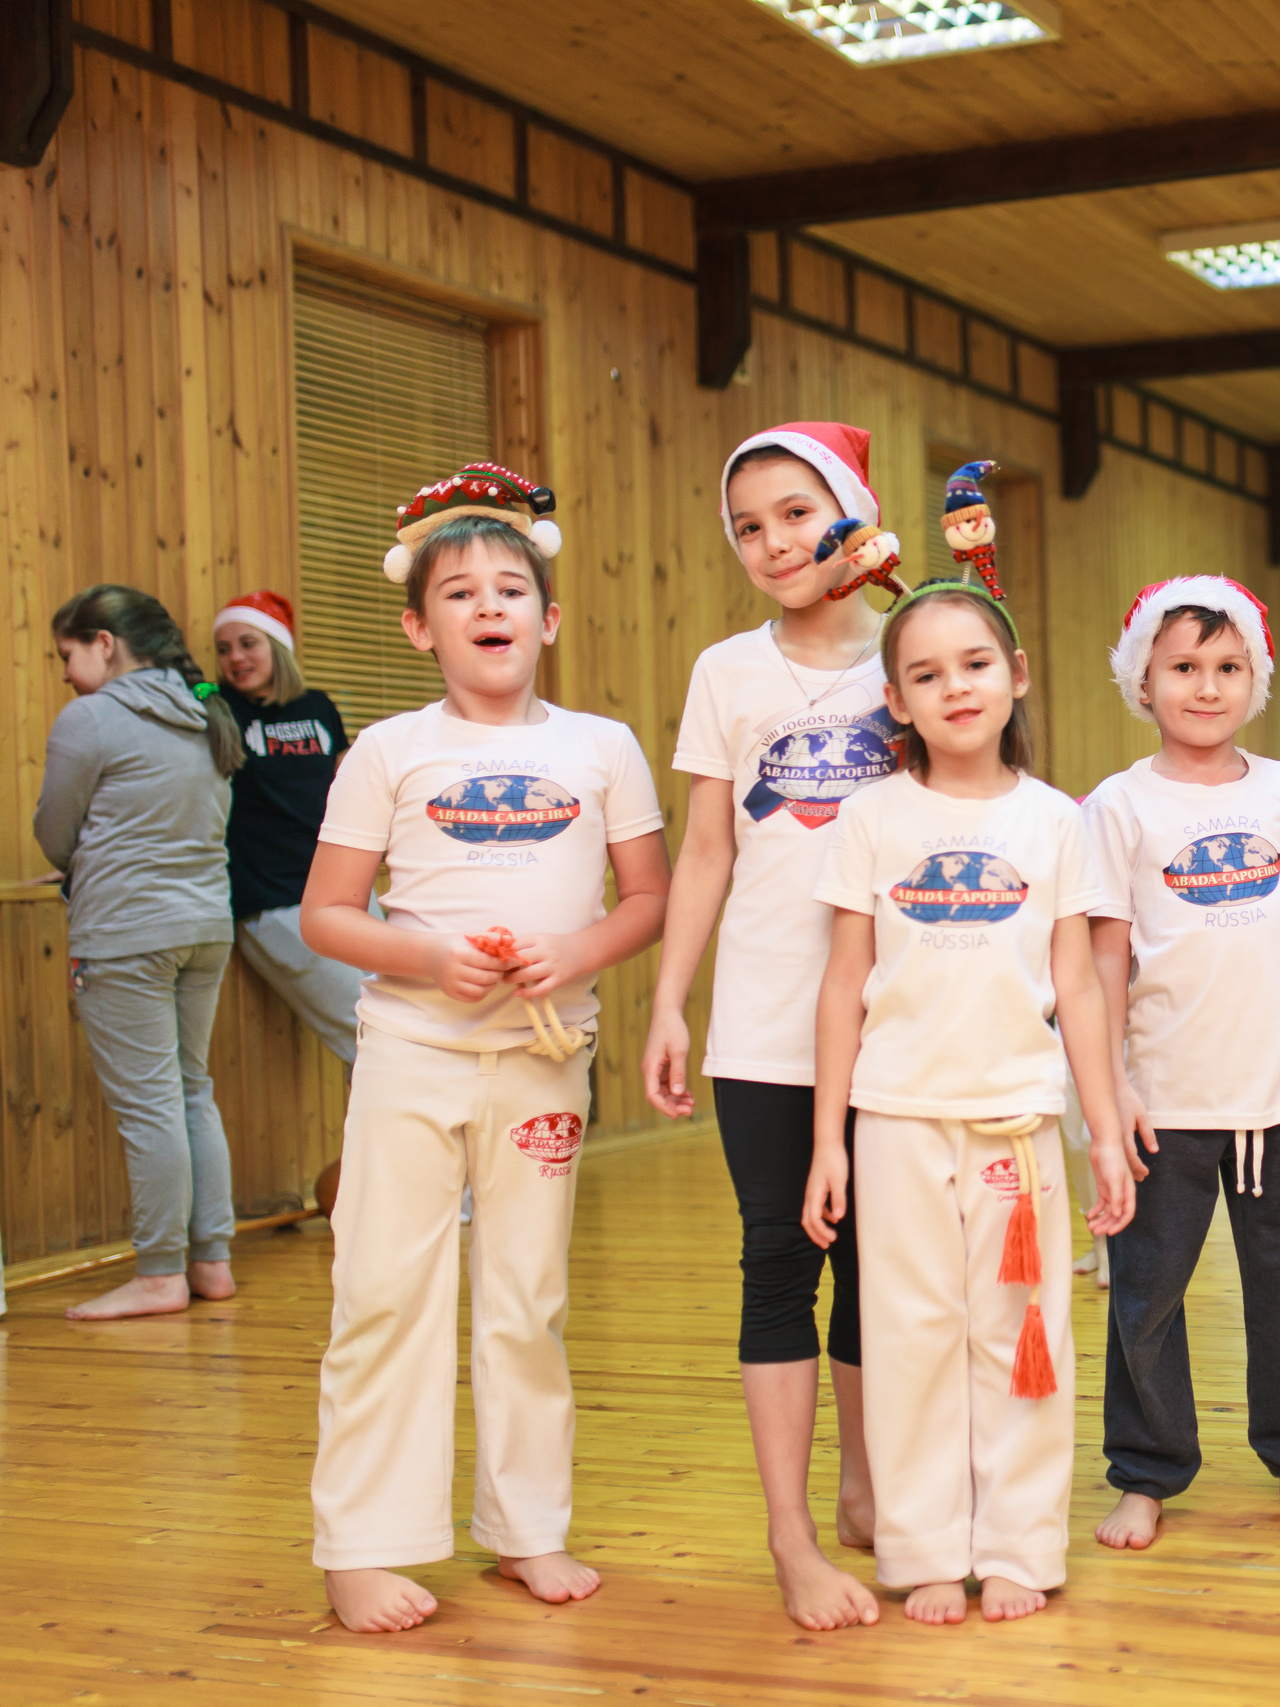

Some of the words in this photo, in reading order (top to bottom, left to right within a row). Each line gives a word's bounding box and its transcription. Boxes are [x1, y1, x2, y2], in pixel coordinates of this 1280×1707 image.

[761, 729, 780, 747] VIII
[781, 715, 826, 734] JOGOS
[829, 714, 848, 725] DA
[461, 759, 550, 777] SAMARA
[783, 800, 837, 817] SAMARA
[1184, 816, 1261, 840] SAMARA
[921, 835, 1007, 854] SAMARA
[1205, 907, 1267, 928] RÚSSIA
